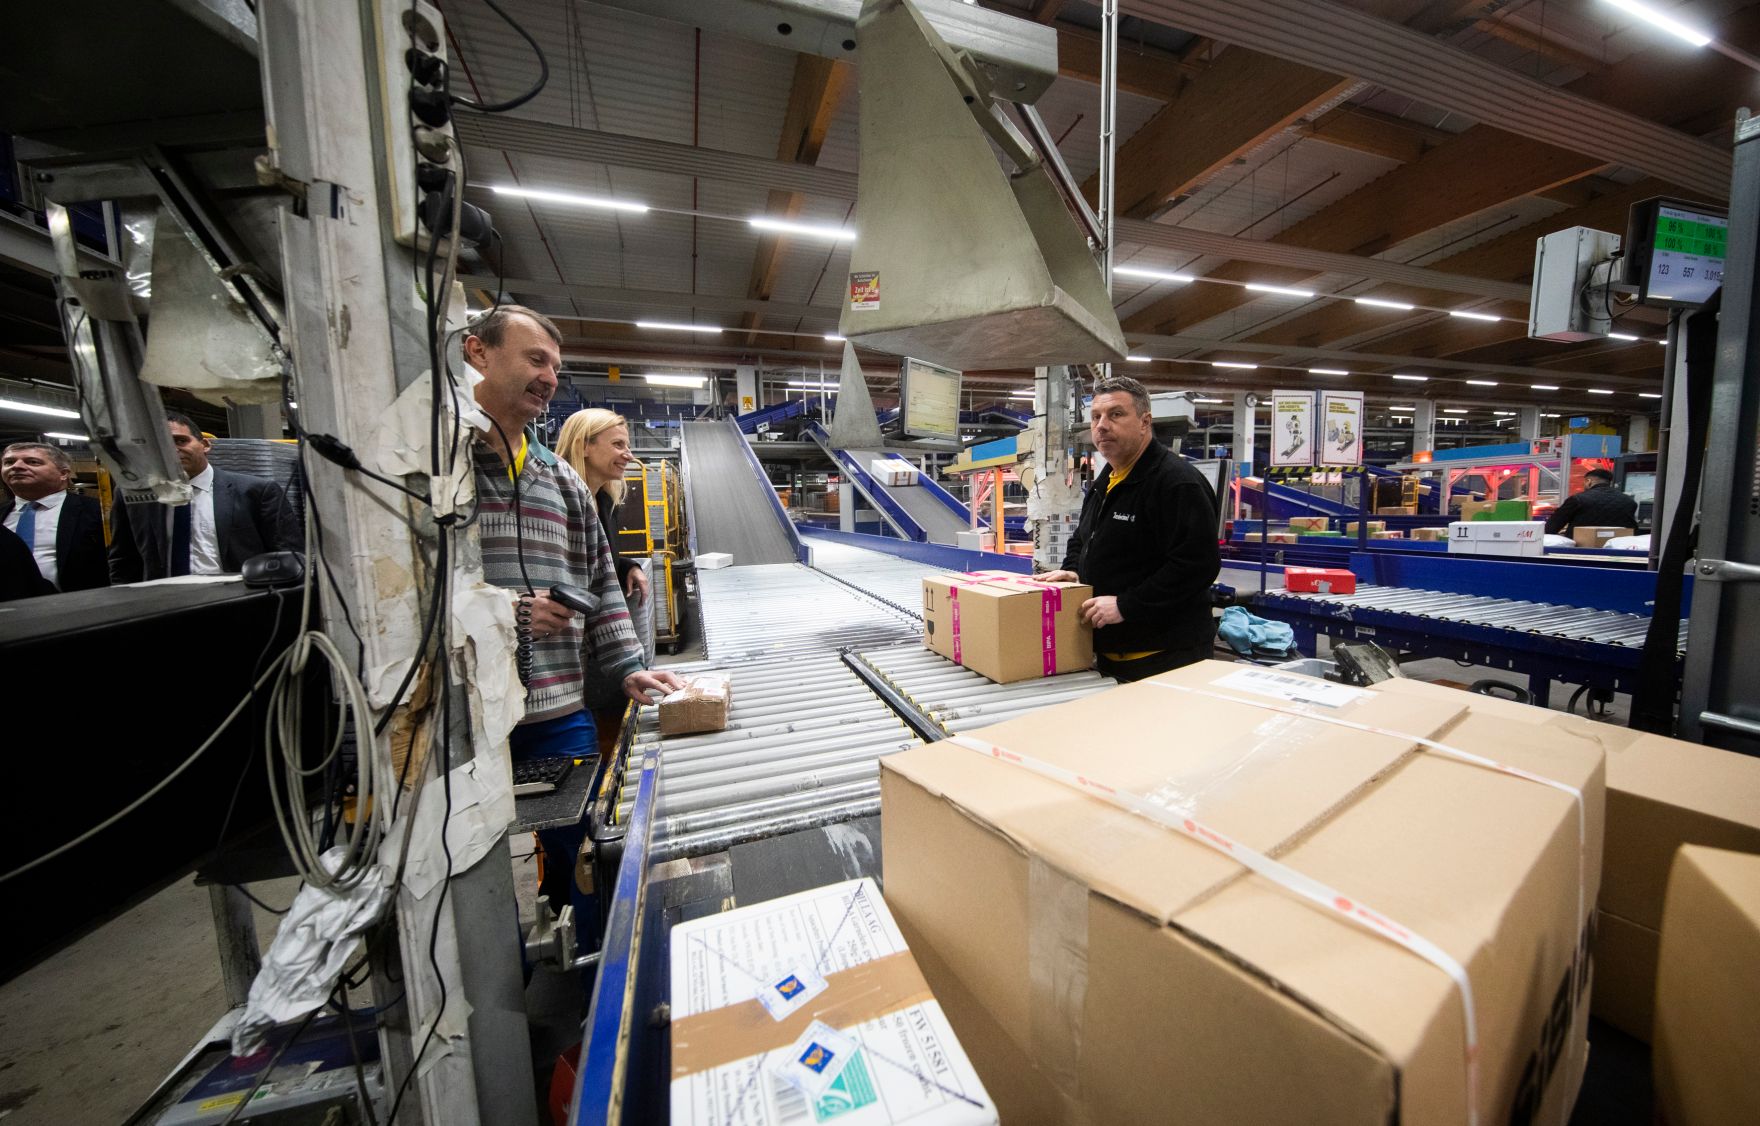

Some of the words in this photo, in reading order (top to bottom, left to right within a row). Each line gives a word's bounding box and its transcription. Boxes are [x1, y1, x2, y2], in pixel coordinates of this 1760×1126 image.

[1658, 264, 1670, 275] 123
[1683, 267, 1695, 278] 557
[853, 890, 875, 918] BILLA
[908, 1010, 928, 1033] FW
